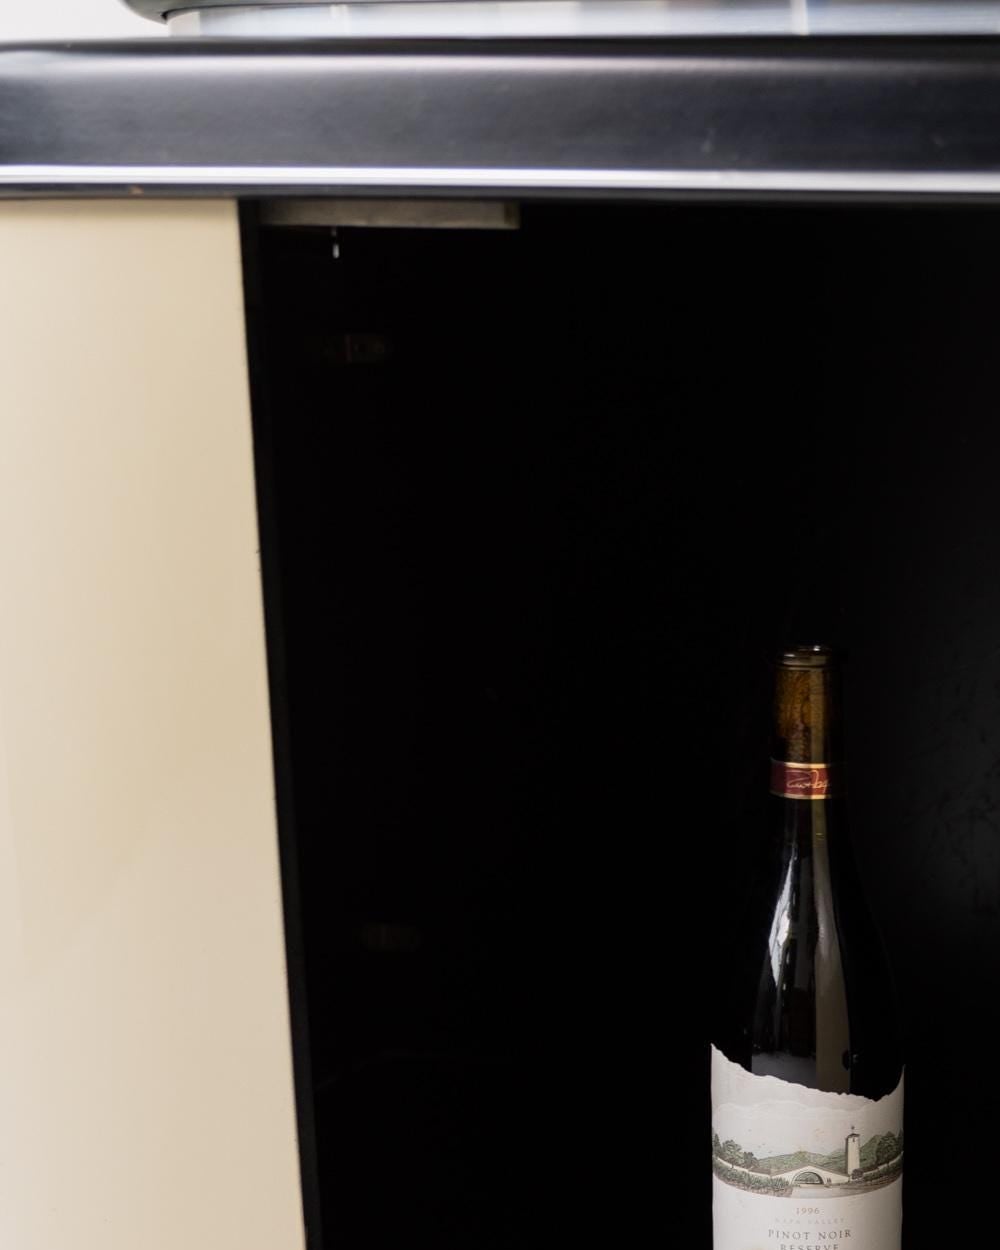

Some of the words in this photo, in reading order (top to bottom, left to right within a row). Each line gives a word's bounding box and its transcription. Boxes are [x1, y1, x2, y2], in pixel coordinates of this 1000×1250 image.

[795, 1207, 820, 1215] 1996
[768, 1229, 810, 1241] PINOT
[818, 1229, 852, 1240] NOIR
